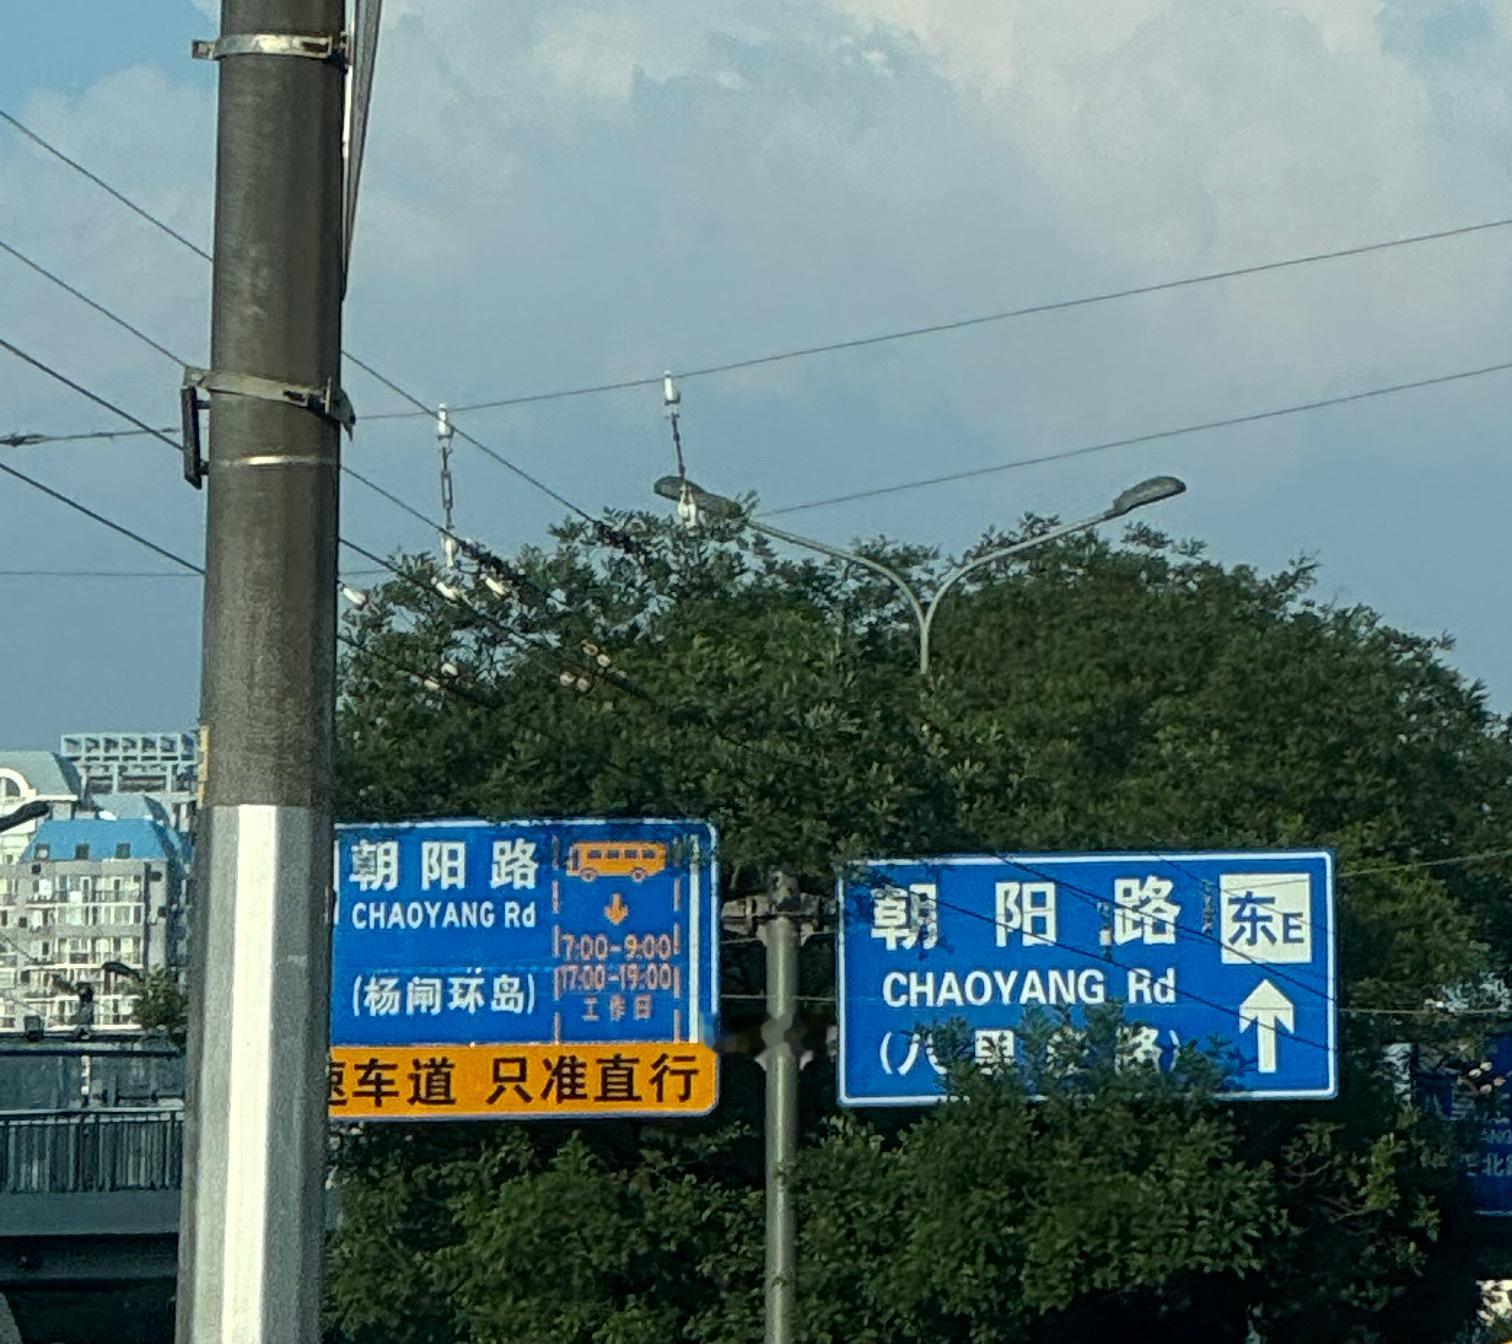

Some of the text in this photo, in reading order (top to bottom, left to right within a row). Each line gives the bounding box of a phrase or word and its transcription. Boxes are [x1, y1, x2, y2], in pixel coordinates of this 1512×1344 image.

[349, 838, 538, 891] 朝阳路
[352, 900, 536, 930] CHAOYANG Rd
[870, 875, 1181, 952] 朝阳路
[560, 933, 672, 961] 7:00-9:00
[352, 972, 535, 1017] (杨闸环岛)
[581, 994, 652, 1022] 工作日
[882, 967, 1177, 1008] CHAOYANG Rd
[485, 1053, 700, 1105] 只准直行
